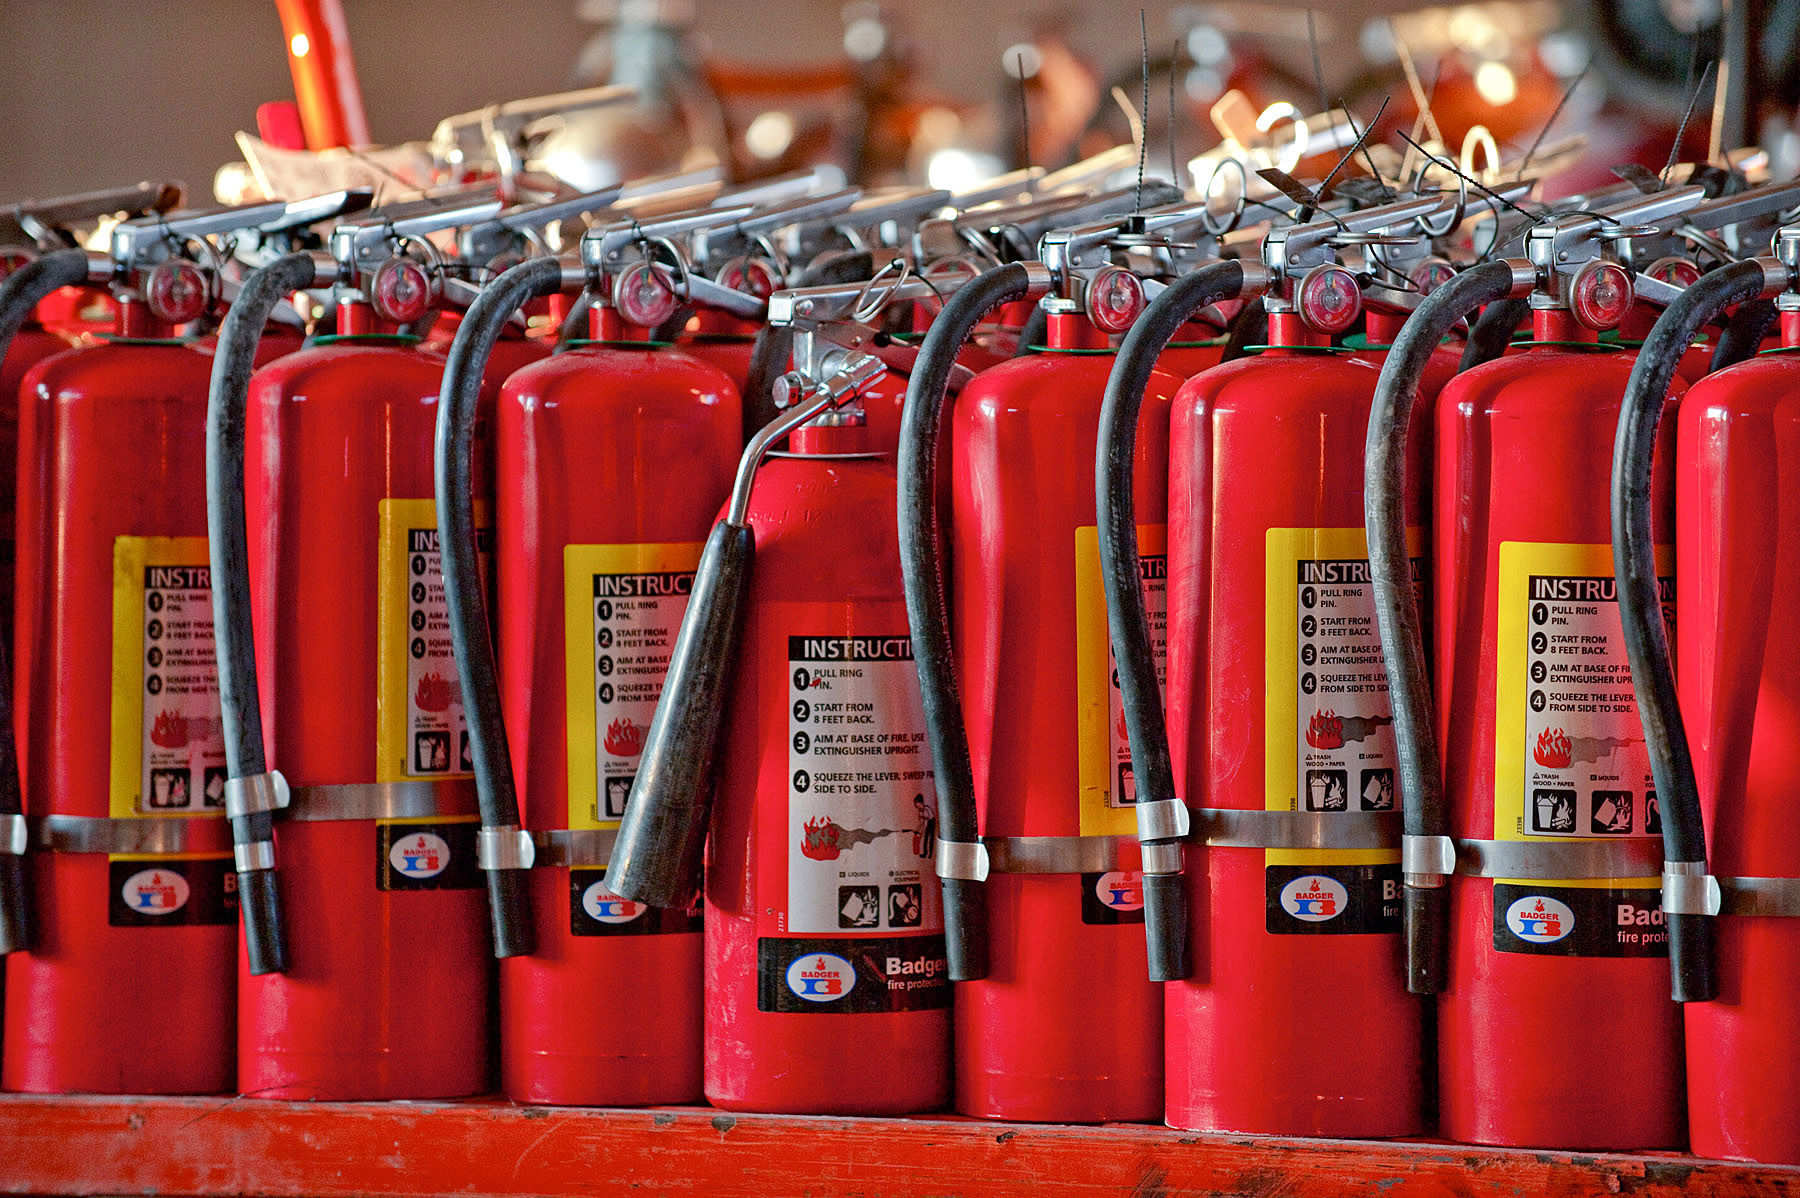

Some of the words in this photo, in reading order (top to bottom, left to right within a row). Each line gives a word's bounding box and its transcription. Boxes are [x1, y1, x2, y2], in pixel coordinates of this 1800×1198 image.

[1320, 589, 1341, 597] PULL
[1343, 589, 1363, 597] RING
[616, 602, 636, 610] PULL
[1320, 600, 1337, 608] PIN.
[1552, 607, 1574, 615] PULL
[1576, 607, 1597, 615] RING
[1320, 618, 1346, 626] START
[1348, 617, 1371, 625] FROM
[1551, 617, 1569, 625] PIN.
[616, 630, 641, 638] START
[644, 629, 668, 637] FROM
[1349, 628, 1372, 636] BACK.
[1340, 646, 1350, 654] AT
[1351, 646, 1371, 654] BASE
[1551, 646, 1556, 654] 8
[1581, 647, 1608, 655] BACK.
[617, 657, 633, 665] AIM
[648, 656, 667, 664] BASE
[1320, 657, 1378, 665] EXTINGUISHER
[814, 669, 838, 678] PULL
[840, 669, 863, 678] RING
[1584, 665, 1606, 673] BASE
[1608, 665, 1619, 673] OF
[1320, 674, 1357, 682] SQUEEZE
[1359, 673, 1373, 682] THE
[1550, 675, 1614, 683] EXTINGUISHER
[617, 684, 653, 692] SQUEEZE
[1320, 685, 1345, 693] FROM
[1347, 685, 1363, 693] SIDE
[1365, 684, 1376, 693] TO
[618, 695, 641, 703] FROM
[1550, 693, 1588, 701] SQUEEZE
[814, 703, 843, 712] START
[846, 703, 873, 712] FROM
[1550, 704, 1575, 712] FROM
[1578, 704, 1598, 712] SIDE
[814, 715, 820, 724] 8
[822, 715, 843, 724] FEET
[847, 715, 875, 724] BACK.
[814, 735, 833, 744] AIM
[837, 735, 848, 743] AT
[851, 735, 874, 743] BASE
[877, 734, 888, 743] OF
[911, 733, 925, 742] USE
[814, 747, 882, 756] EXTINGUISHER
[814, 773, 854, 782] SQUEEZE
[856, 773, 872, 782] THE
[814, 785, 835, 794] SIDE
[838, 785, 851, 794] TO
[854, 785, 877, 794] SIDE.
[1520, 912, 1560, 921] BADGER
[1617, 930, 1639, 943] fire
[801, 971, 840, 979] BADGER
[887, 980, 905, 990] fire
